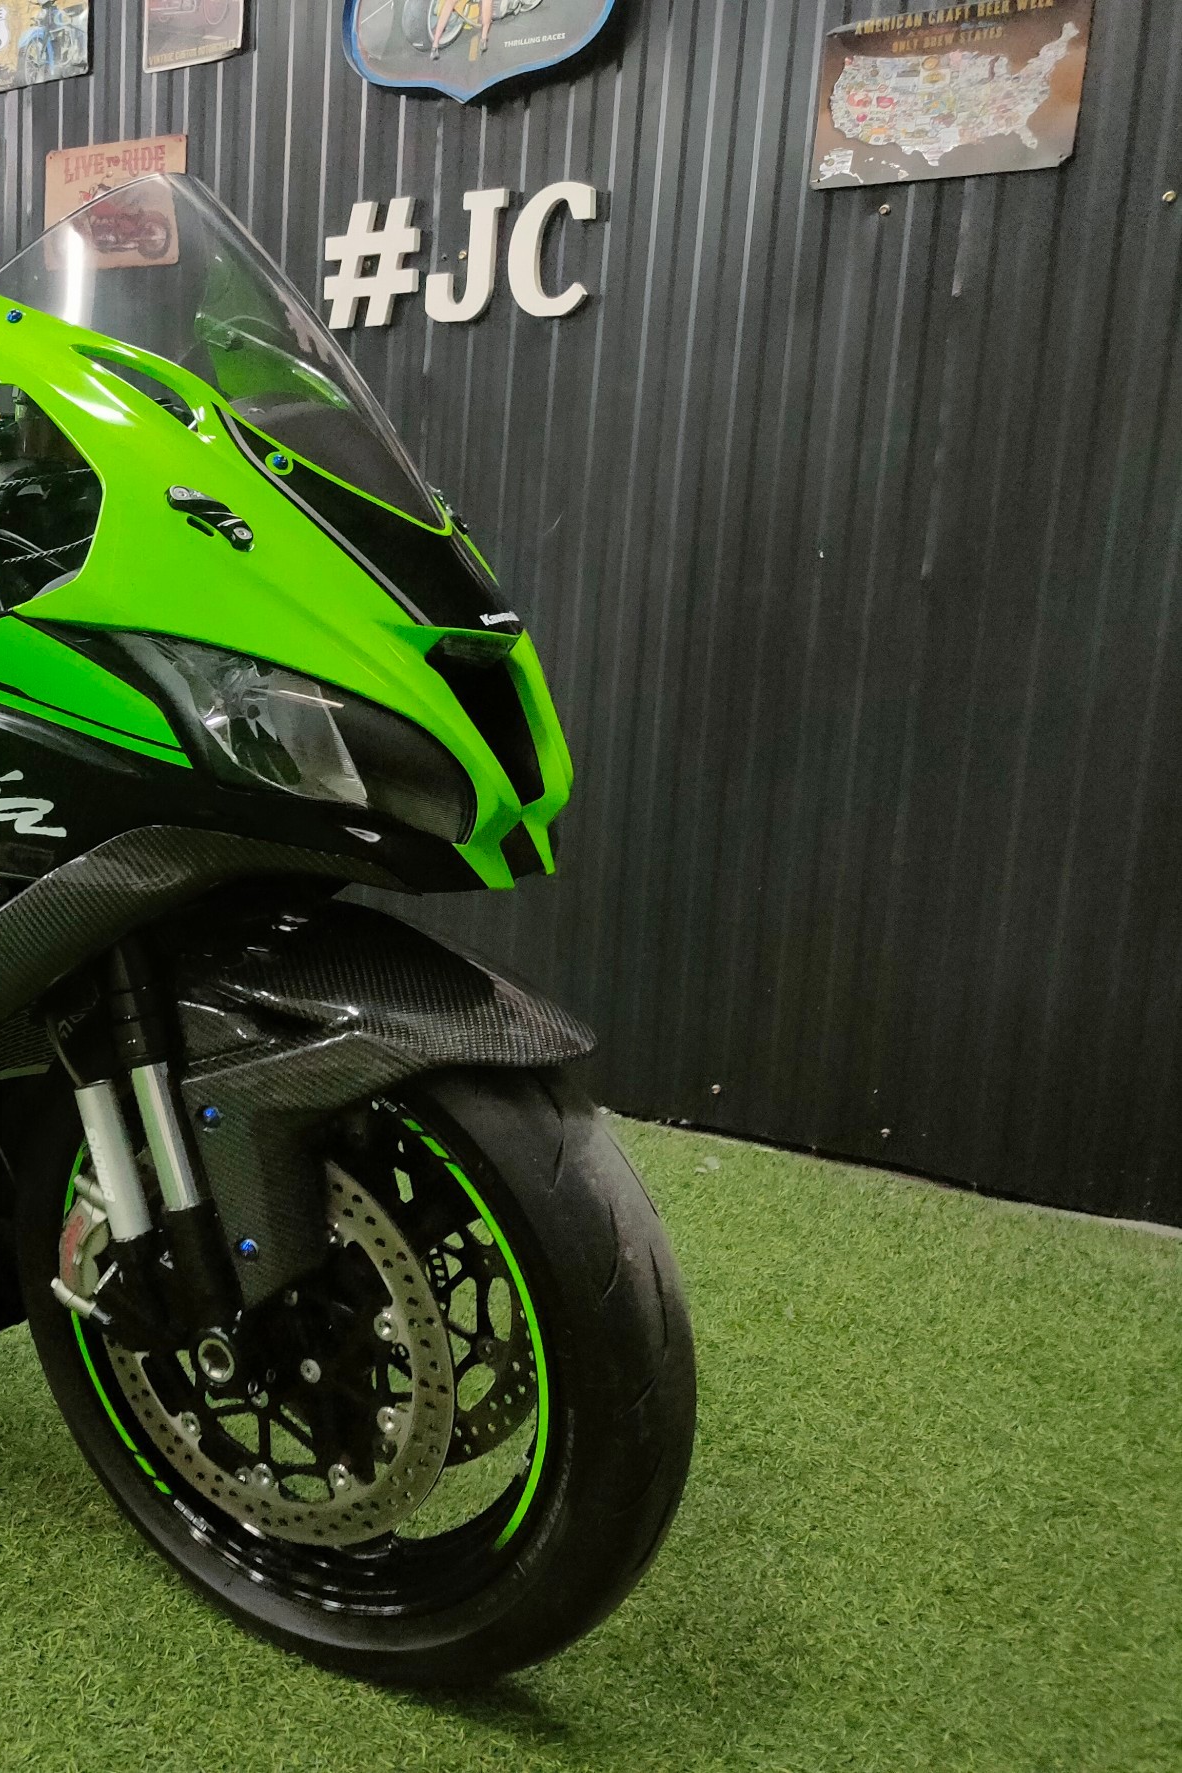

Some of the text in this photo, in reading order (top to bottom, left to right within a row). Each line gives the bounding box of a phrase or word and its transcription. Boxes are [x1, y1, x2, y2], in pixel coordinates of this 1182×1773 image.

[855, 12, 923, 35] AMERICAN
[928, 6, 970, 25] CRAFT
[977, 0, 1010, 17] BEER
[504, 32, 566, 48] THRILLING RACES
[64, 153, 105, 185] LIVE
[121, 144, 166, 178] RIDE
[324, 181, 597, 330] #JC
